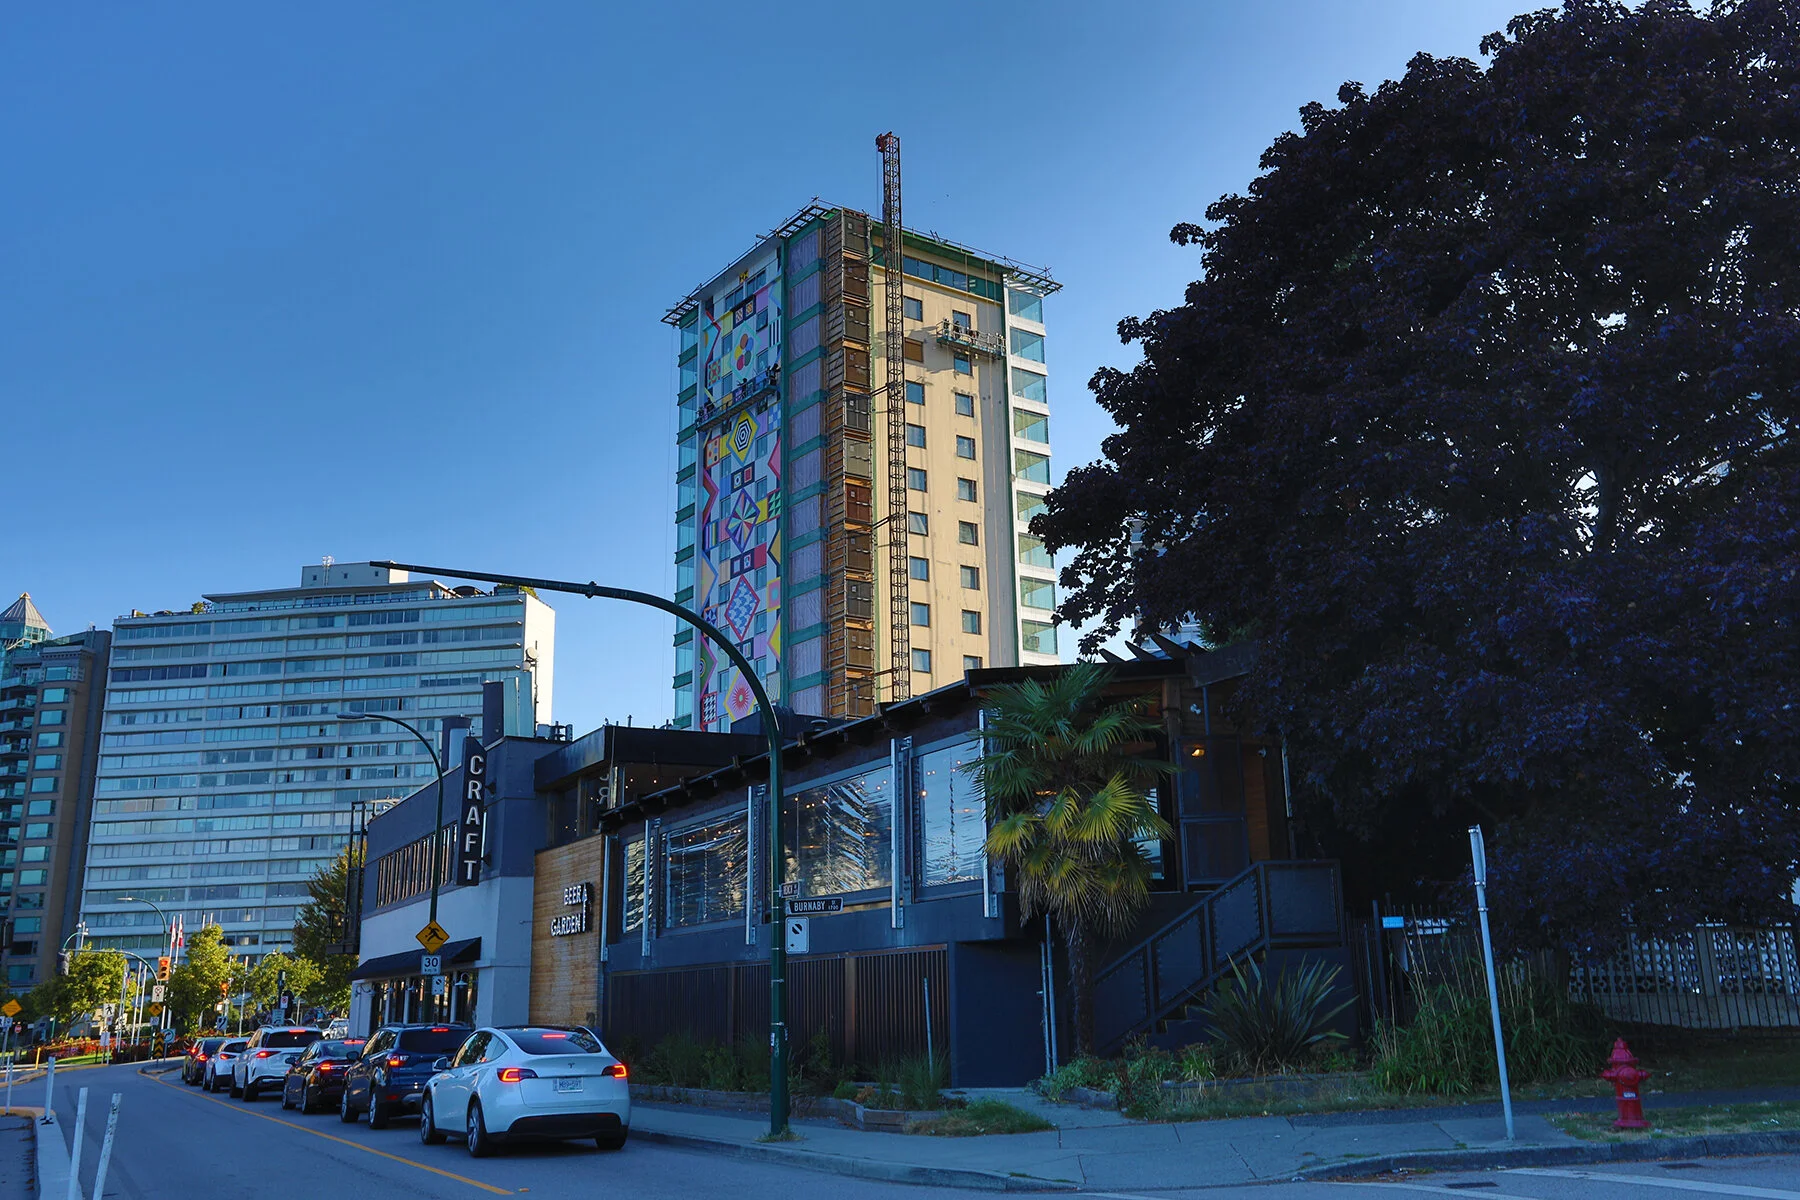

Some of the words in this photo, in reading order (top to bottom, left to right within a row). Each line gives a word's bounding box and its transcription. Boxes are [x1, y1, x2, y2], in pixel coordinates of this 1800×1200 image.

[463, 754, 484, 881] CRAFT
[564, 885, 582, 906] BEER
[794, 901, 826, 912] BURNABY
[550, 913, 581, 937] GARDEN
[424, 957, 439, 968] 30
